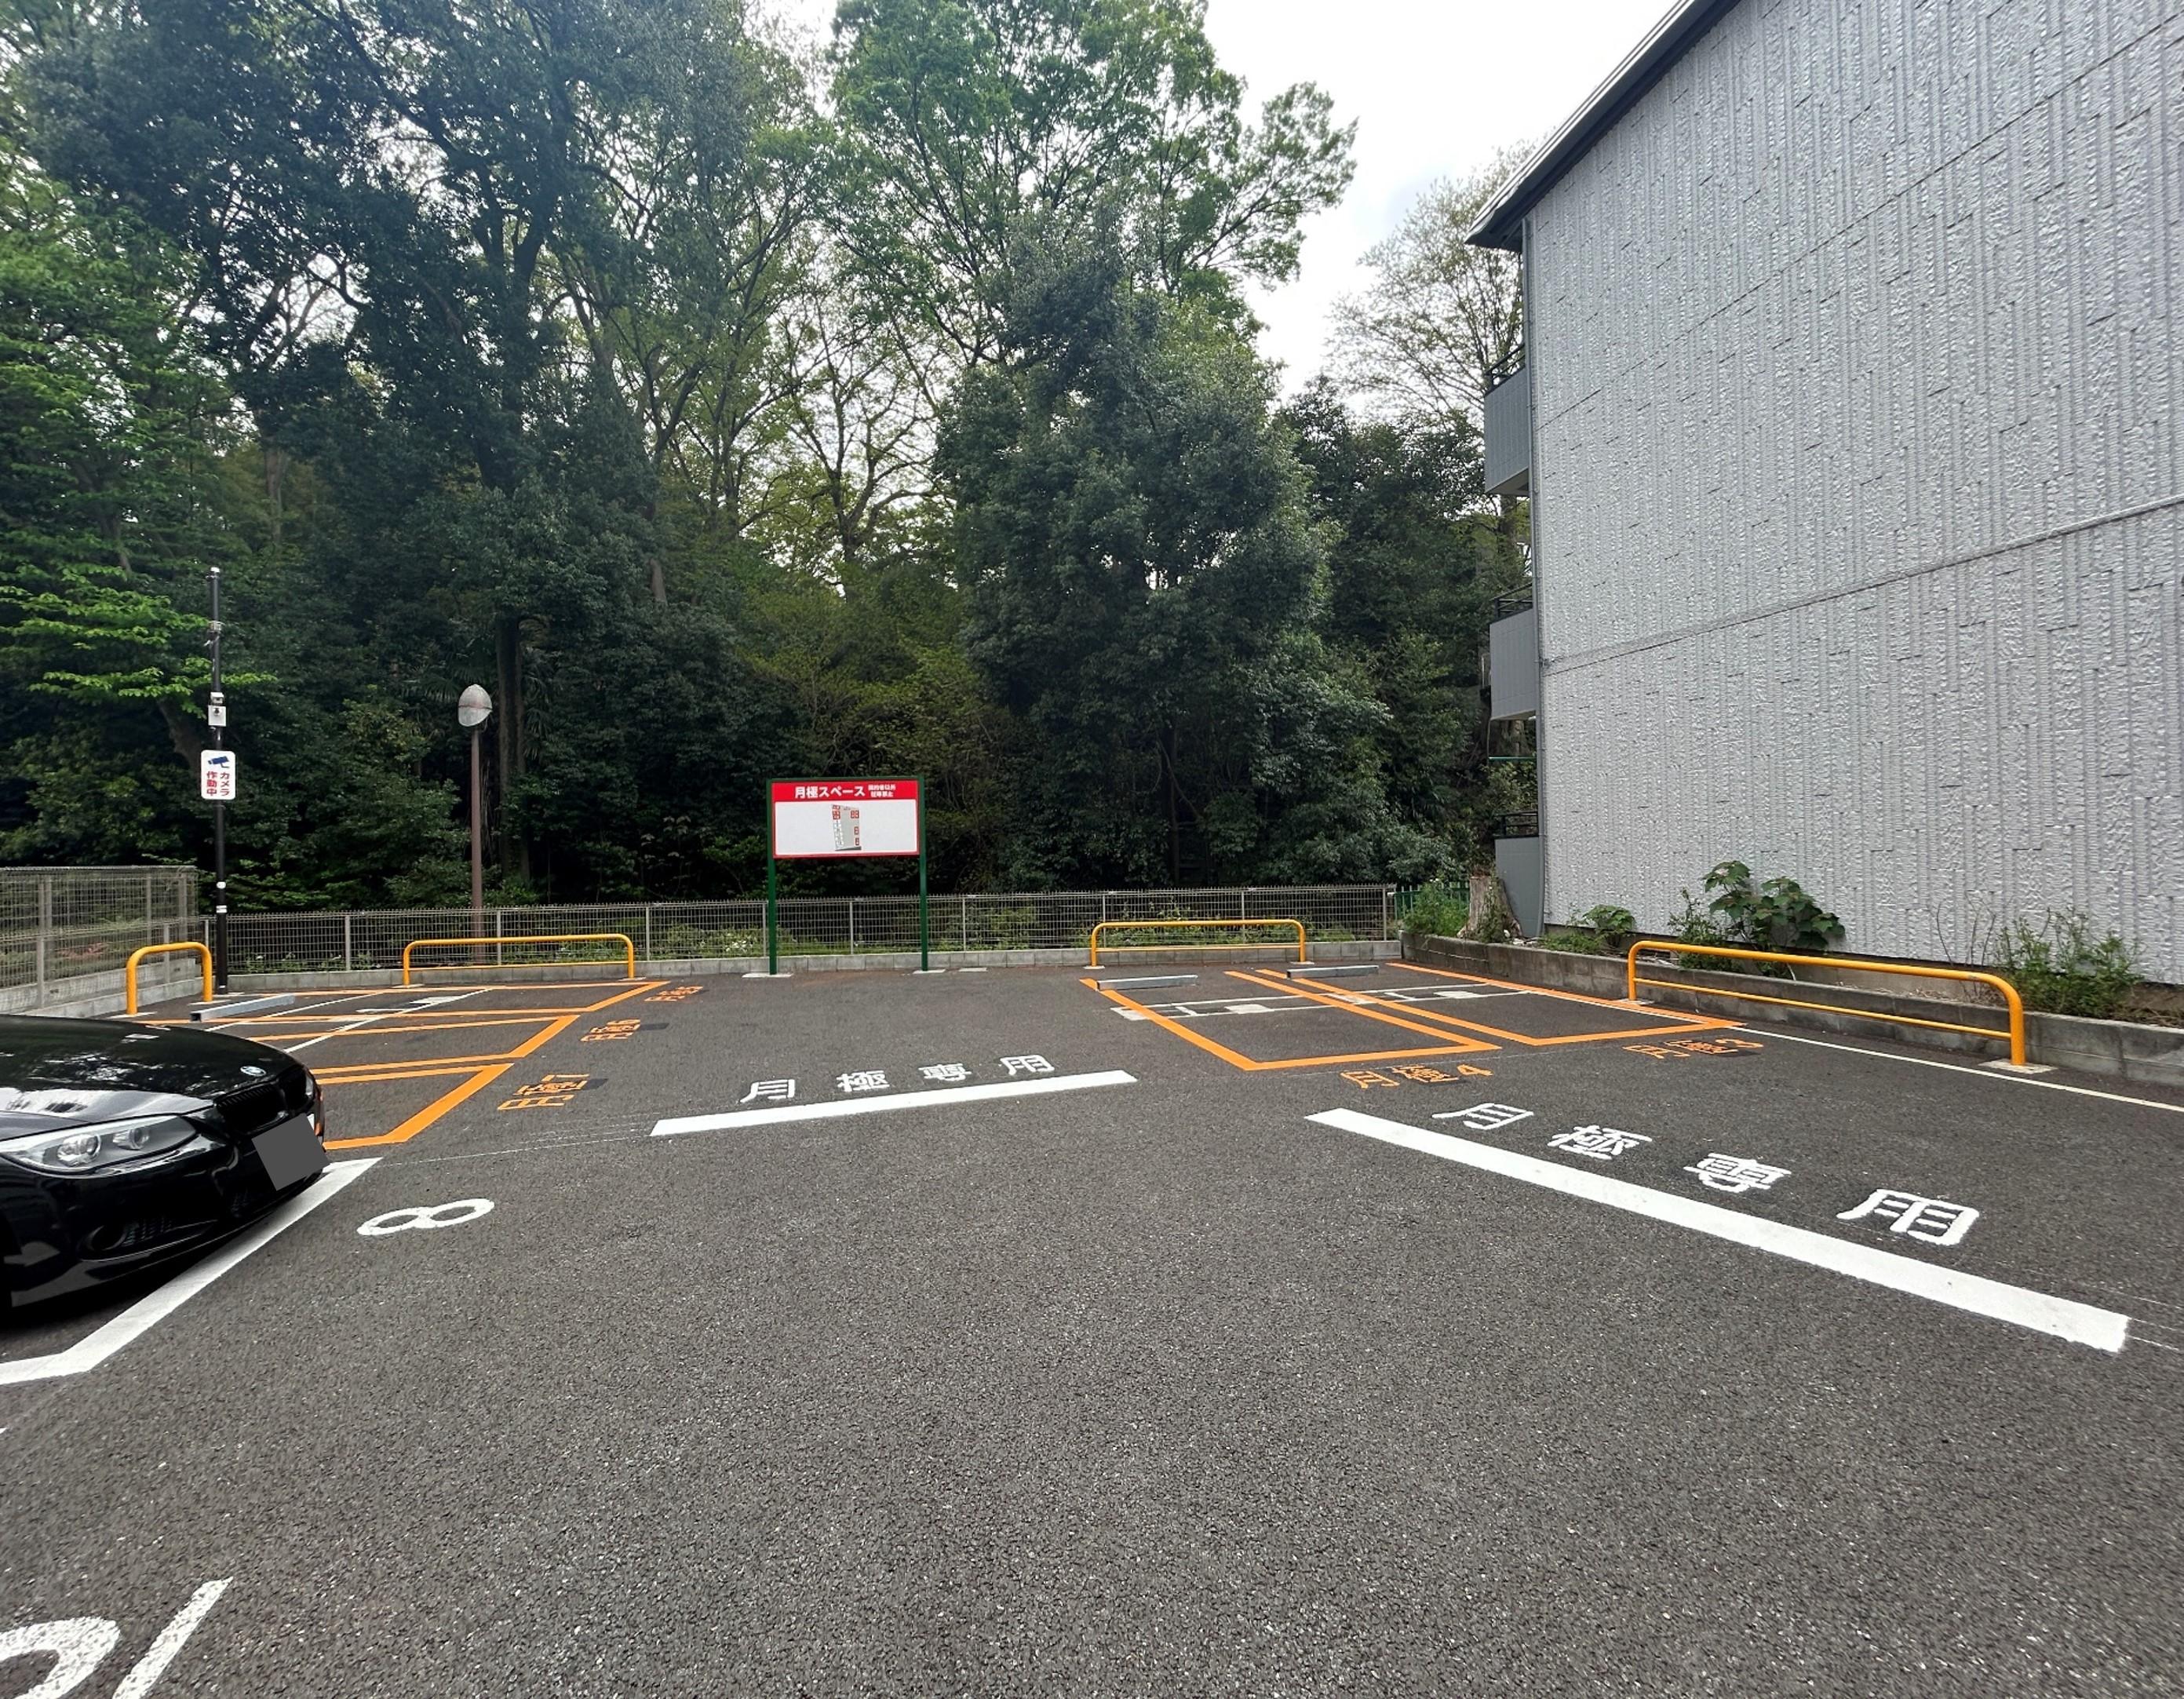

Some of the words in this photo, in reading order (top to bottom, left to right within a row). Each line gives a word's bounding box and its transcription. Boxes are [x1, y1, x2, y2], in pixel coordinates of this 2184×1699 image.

[206, 771, 218, 797] 作動中
[220, 771, 230, 797] カメラ
[794, 786, 866, 799] 月極スペース
[1621, 1038, 1764, 1059] 月極3
[738, 1054, 1056, 1103] 月極専用
[1340, 1063, 1493, 1089] 月極4
[1431, 1102, 1980, 1245] 月極専用
[356, 1198, 495, 1236] 8
